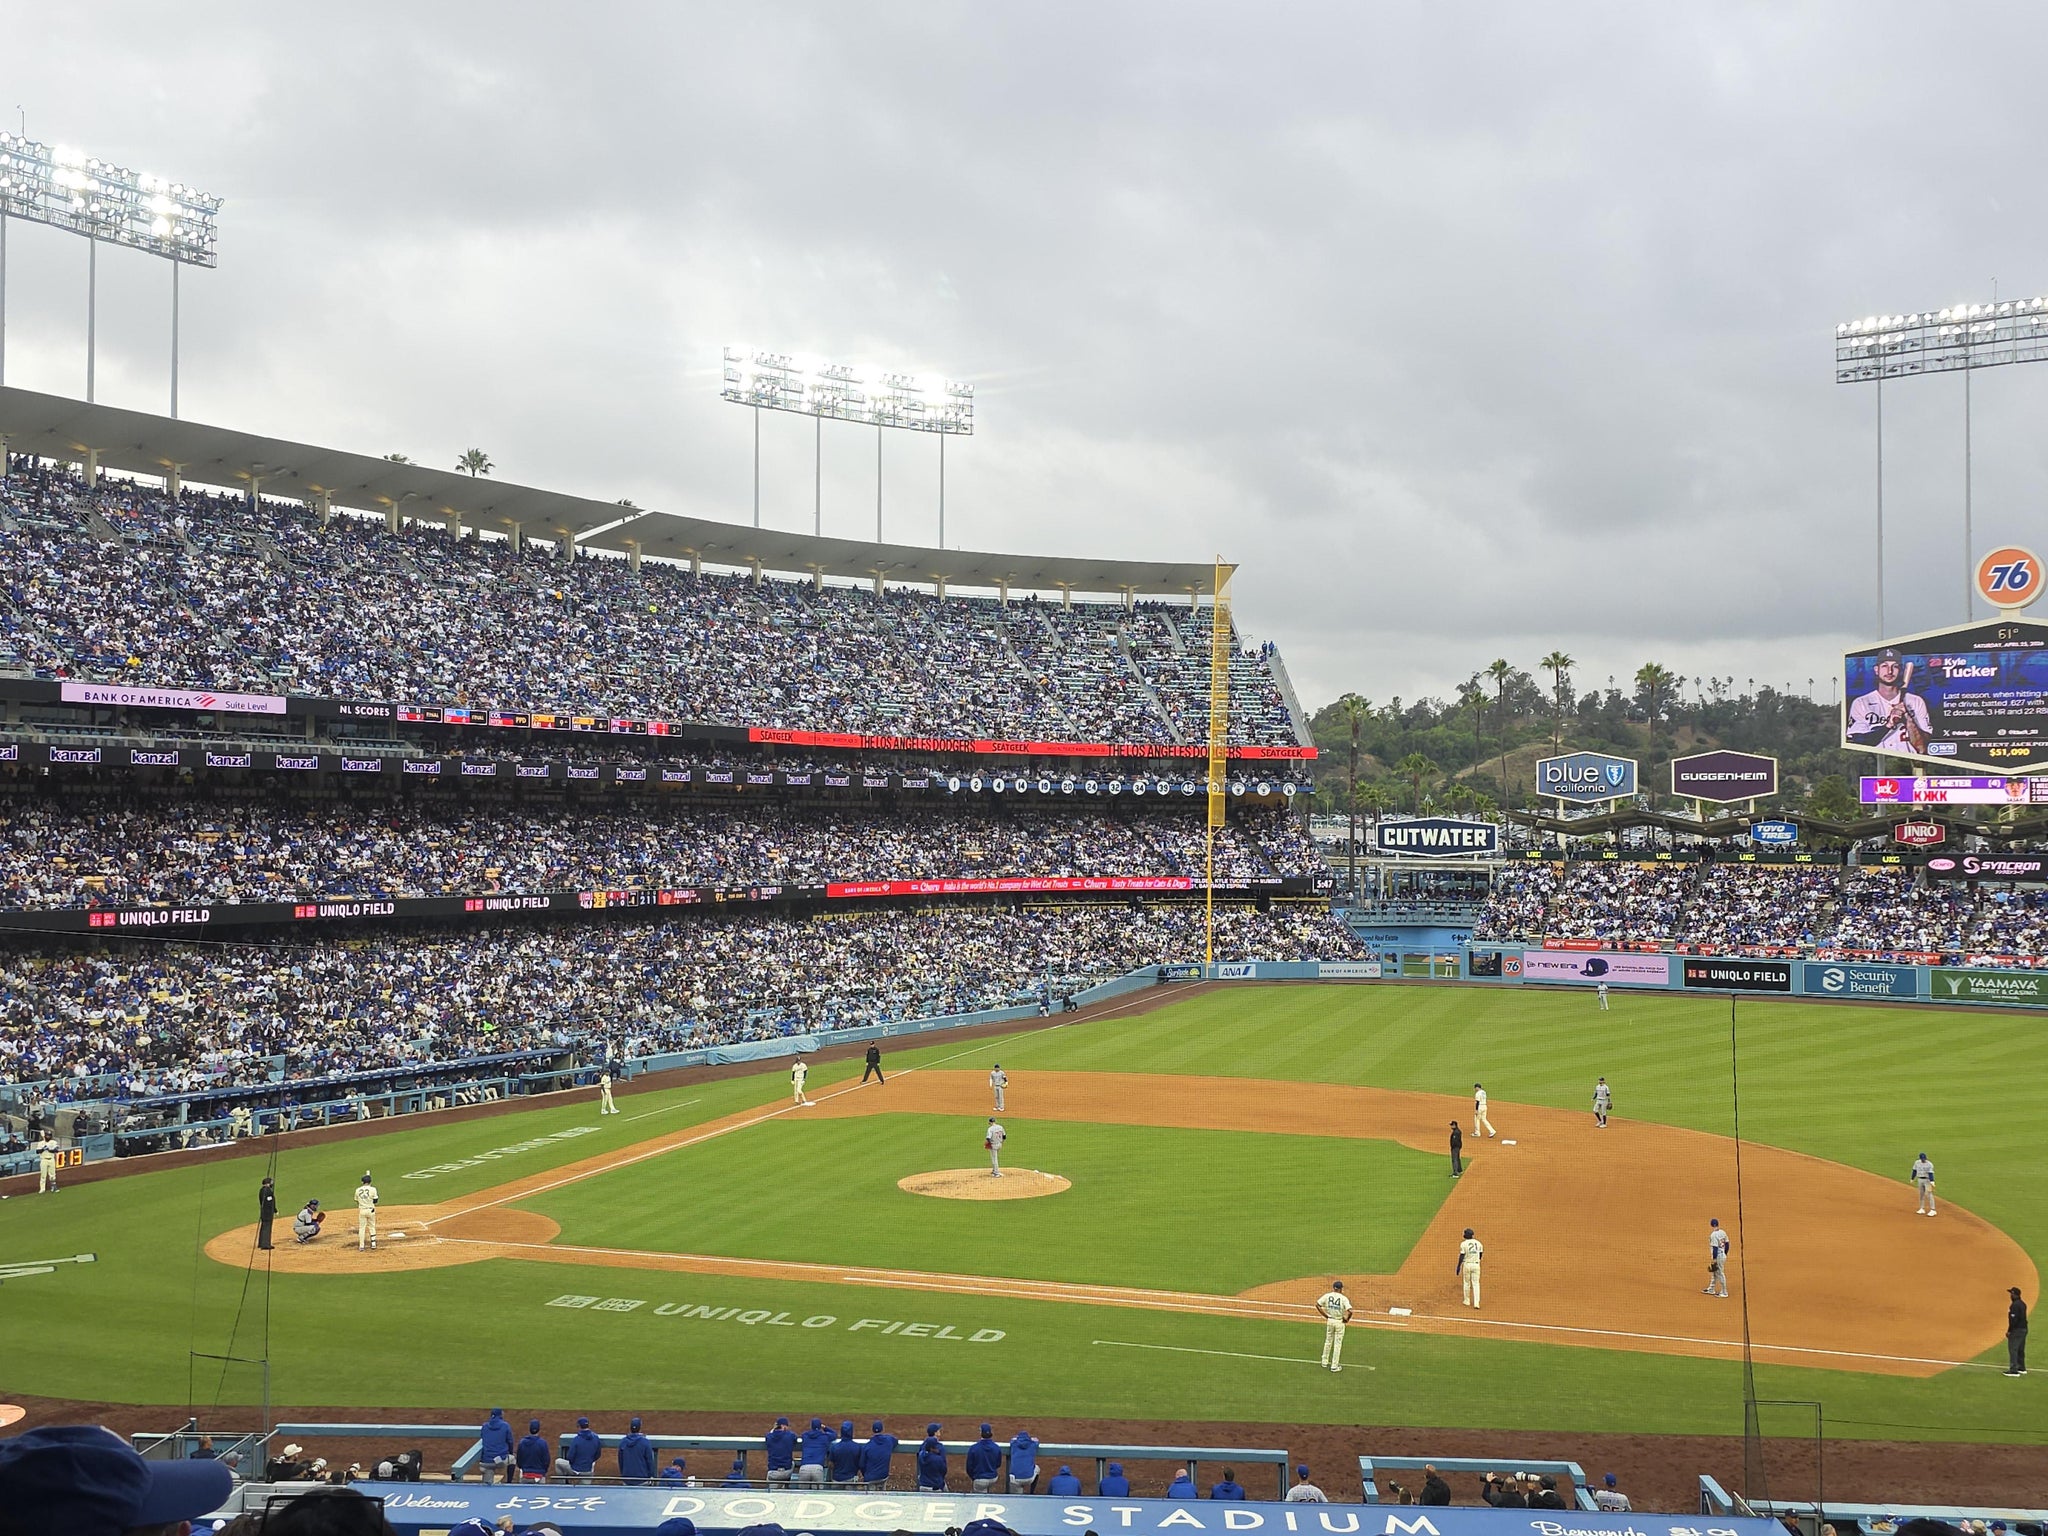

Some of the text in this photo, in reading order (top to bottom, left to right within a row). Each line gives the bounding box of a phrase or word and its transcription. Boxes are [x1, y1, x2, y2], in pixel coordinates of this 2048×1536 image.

[1988, 560, 2031, 591] 76
[1944, 658, 1967, 669] Kyle
[1943, 665, 1998, 678] Tucker
[85, 692, 268, 711] BANK OF AMERICA Suite Level
[1944, 692, 1960, 700] Last
[2016, 690, 2041, 699] hitting
[340, 705, 390, 716] NL SCORES
[761, 730, 794, 742] SEATGEEK
[861, 735, 877, 750] THE
[878, 736, 892, 750] LOS
[894, 736, 932, 751] ANGELES
[933, 738, 976, 753] DODGERS
[992, 742, 1030, 753] SEATGEEK
[1108, 744, 1125, 757] THE
[1127, 744, 1144, 757] LOS
[1149, 745, 1191, 758] ANGELES
[1261, 748, 1303, 758] SEATGEEK
[1546, 762, 1600, 783] blue
[1681, 771, 1768, 782] GUGGENHEIM
[1018, 782, 1026, 793] 14
[1041, 782, 1048, 792] 19
[1064, 783, 1073, 793] 20
[1087, 783, 1097, 793] 24
[1111, 783, 1120, 793] 32
[1135, 783, 1145, 794] 34
[1159, 783, 1168, 794] 39
[1555, 783, 1606, 793] california
[1757, 825, 1785, 833] TOYO
[1761, 831, 1792, 840] TIRES
[1903, 825, 1938, 838] JINRO
[1384, 828, 1488, 847] CUTWATER
[1603, 851, 1619, 860] UKG
[1656, 852, 1673, 860] UKG
[1739, 854, 1756, 862] UKG
[1795, 854, 1812, 863] UKG
[1882, 855, 1900, 864] UKG
[1981, 861, 2042, 871] SYNCRON
[920, 883, 940, 892] Churu
[1052, 879, 1069, 888] Treats
[1084, 879, 1108, 889] Churu
[1112, 879, 1126, 889] Tasty
[1127, 879, 1144, 888] Treats
[1154, 878, 1167, 888] Cats
[1172, 878, 1188, 889] Dogs
[1316, 879, 1334, 890] 5:47
[674, 890, 690, 899] ASSAD
[715, 893, 724, 903] 93
[320, 904, 360, 918] UNIQLO
[363, 902, 395, 915] FIELD
[486, 898, 521, 911] UNIQLO
[523, 896, 550, 909] FIELD
[119, 911, 169, 926] UNIQLO
[172, 909, 210, 923] FIELD
[1222, 967, 1242, 977] ANA
[1506, 960, 1519, 971] 76
[1711, 969, 1750, 982] UNIQLO
[1754, 971, 1787, 983] FIELD
[1850, 969, 1897, 985] Security
[1850, 980, 1891, 994] Benefit
[1971, 987, 2001, 995] RESORT
[359, 1188, 370, 1199] 23
[1469, 1242, 1478, 1251] 21
[653, 1302, 1007, 1343] UNIQLO FIELD
[384, 1492, 470, 1509] Welcome
[496, 1496, 607, 1512] ようこそ
[662, 1496, 1442, 1536] DODGER STADIUM
